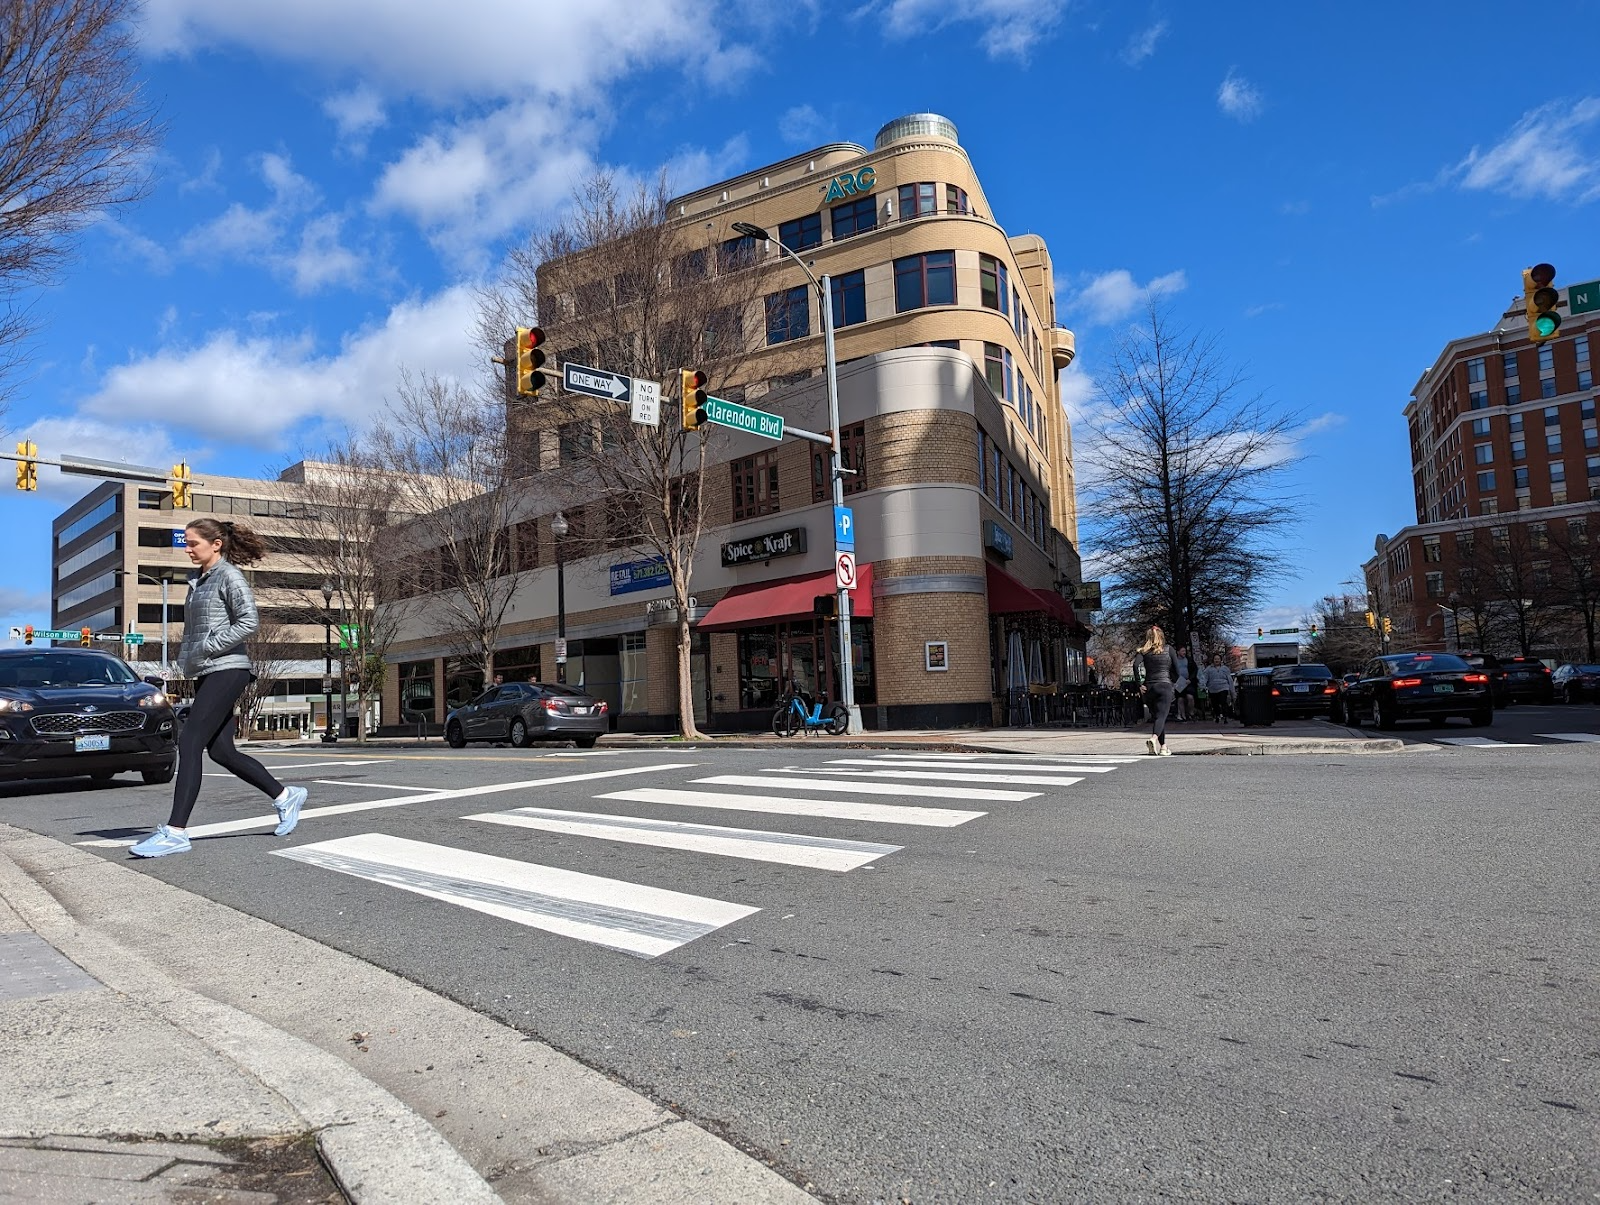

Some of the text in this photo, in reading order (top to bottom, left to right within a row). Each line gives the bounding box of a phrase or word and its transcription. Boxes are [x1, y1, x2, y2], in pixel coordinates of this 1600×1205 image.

[825, 166, 877, 203] ARC
[1576, 292, 1588, 305] N
[572, 373, 612, 391] ONE WAY
[640, 384, 653, 394] NO
[638, 393, 655, 404] TURN
[641, 403, 651, 412] ON
[639, 412, 651, 421] RED
[706, 401, 780, 436] Clarendon Blvd
[842, 514, 851, 535] P
[727, 532, 793, 562] Spice Kraft
[33, 630, 79, 640] Wilson Blvd
